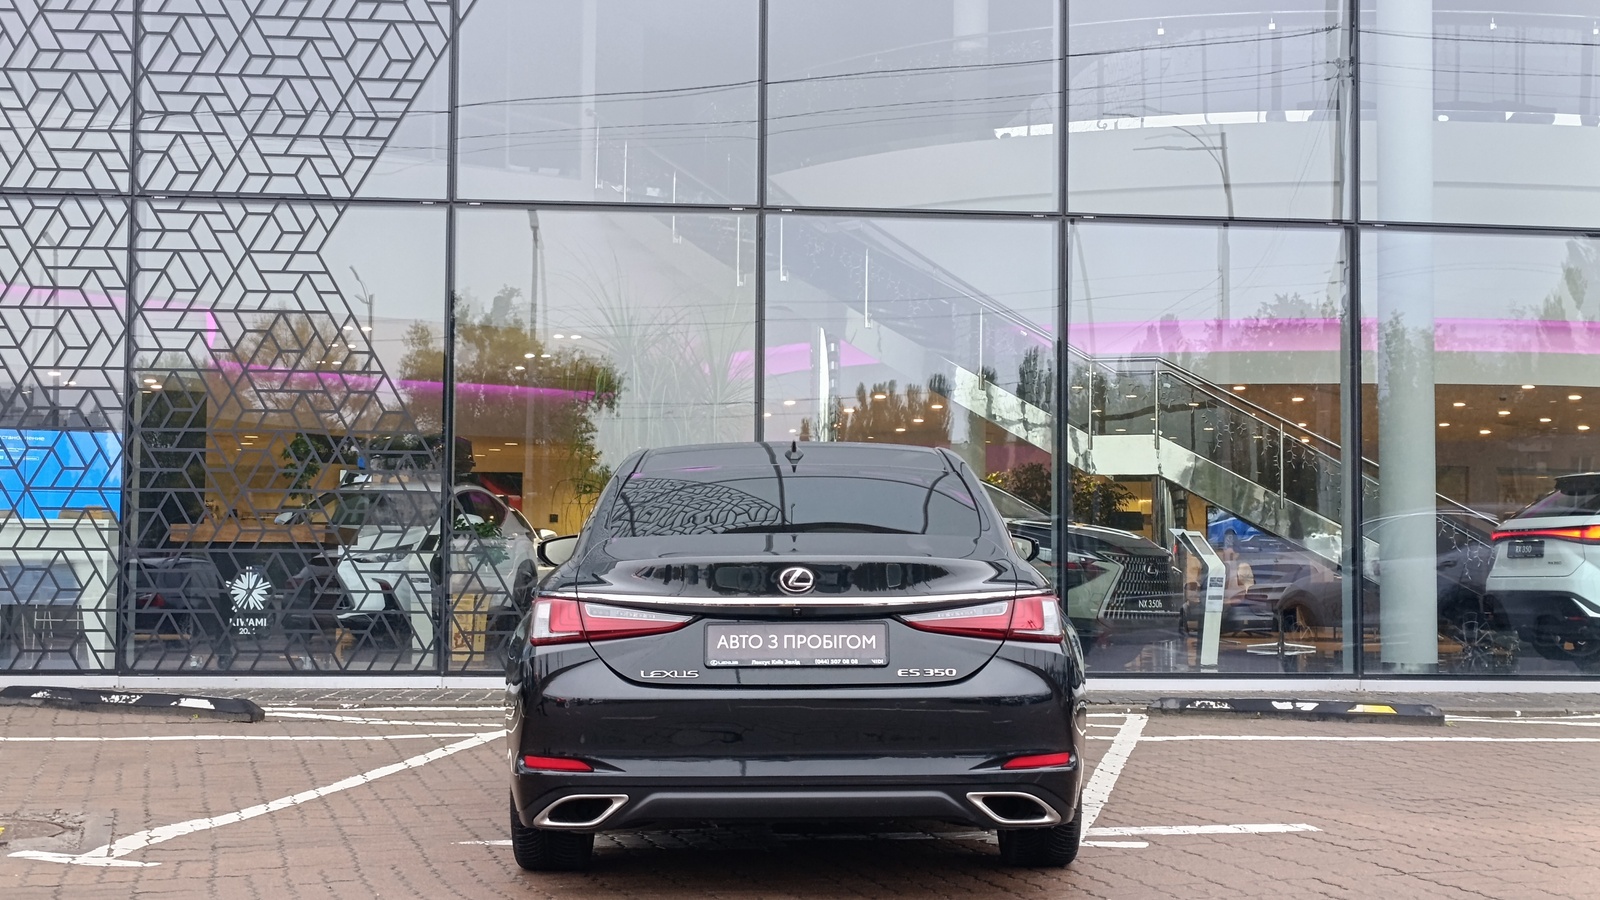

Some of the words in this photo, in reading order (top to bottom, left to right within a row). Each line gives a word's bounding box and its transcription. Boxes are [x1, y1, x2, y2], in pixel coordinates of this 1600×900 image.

[1138, 600, 1147, 608] NX
[716, 634, 763, 649] АВТО
[767, 634, 779, 649] З
[783, 634, 876, 649] ПРОБІГОМ
[640, 670, 699, 678] LEXUS
[897, 668, 921, 677] ES
[923, 668, 957, 677] 350
